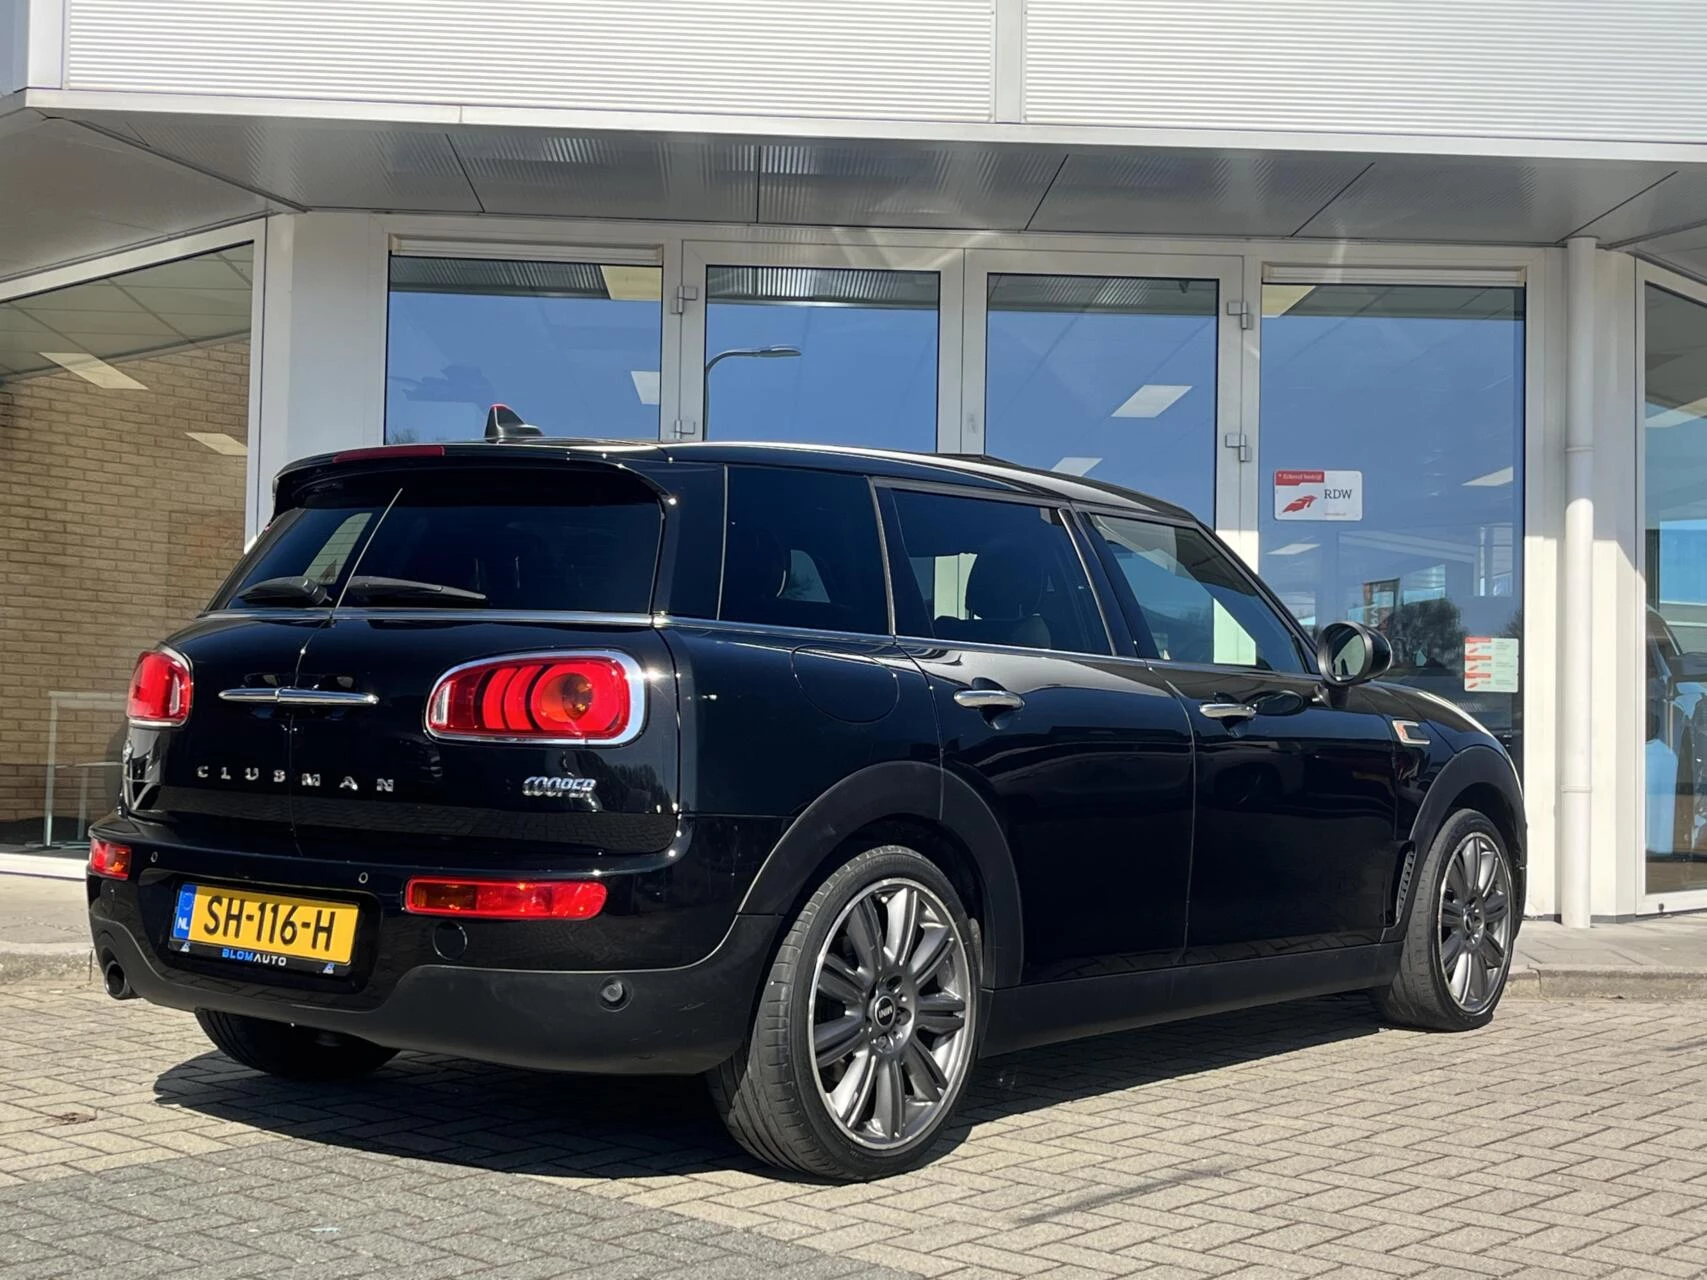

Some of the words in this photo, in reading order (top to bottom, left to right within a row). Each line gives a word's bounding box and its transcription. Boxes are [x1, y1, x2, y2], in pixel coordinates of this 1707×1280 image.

[1324, 489, 1352, 499] RDW
[196, 765, 394, 792] CLUBMAN
[522, 776, 597, 798] COOPER
[177, 917, 189, 930] NL
[203, 895, 336, 951] SH-116-H
